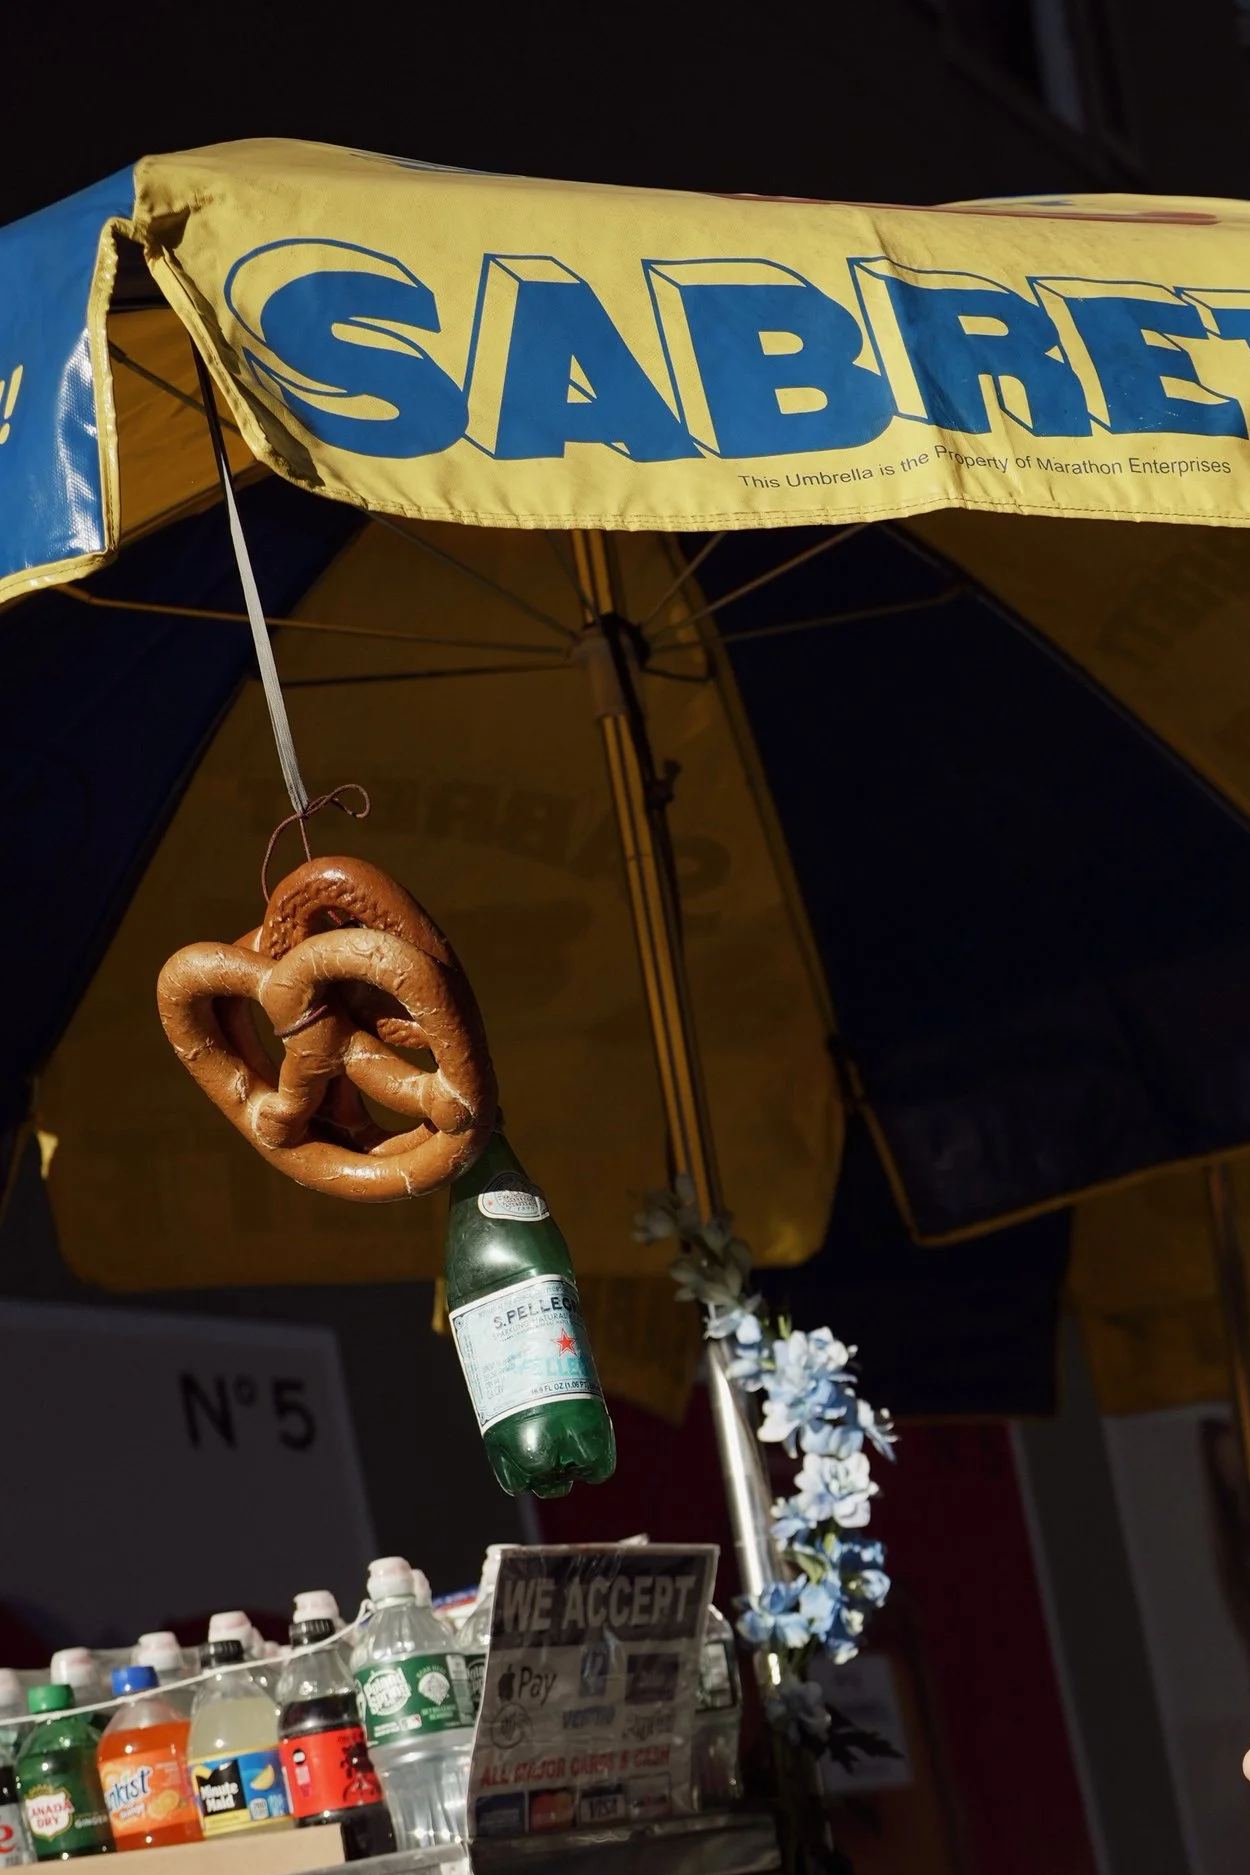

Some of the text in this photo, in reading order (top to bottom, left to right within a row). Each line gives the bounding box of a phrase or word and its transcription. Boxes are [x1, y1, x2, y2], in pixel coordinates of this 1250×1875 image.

[738, 444, 1232, 489] This Umbrella is the Property of Marathon Enterprises
[554, 1382, 563, 1390] OZ
[503, 1575, 695, 1632] WE ACCEPT
[518, 1667, 557, 1708] Pay
[200, 1780, 239, 1803] Minute
[205, 1795, 235, 1812] Maid
[37, 1817, 59, 1828] DRY
